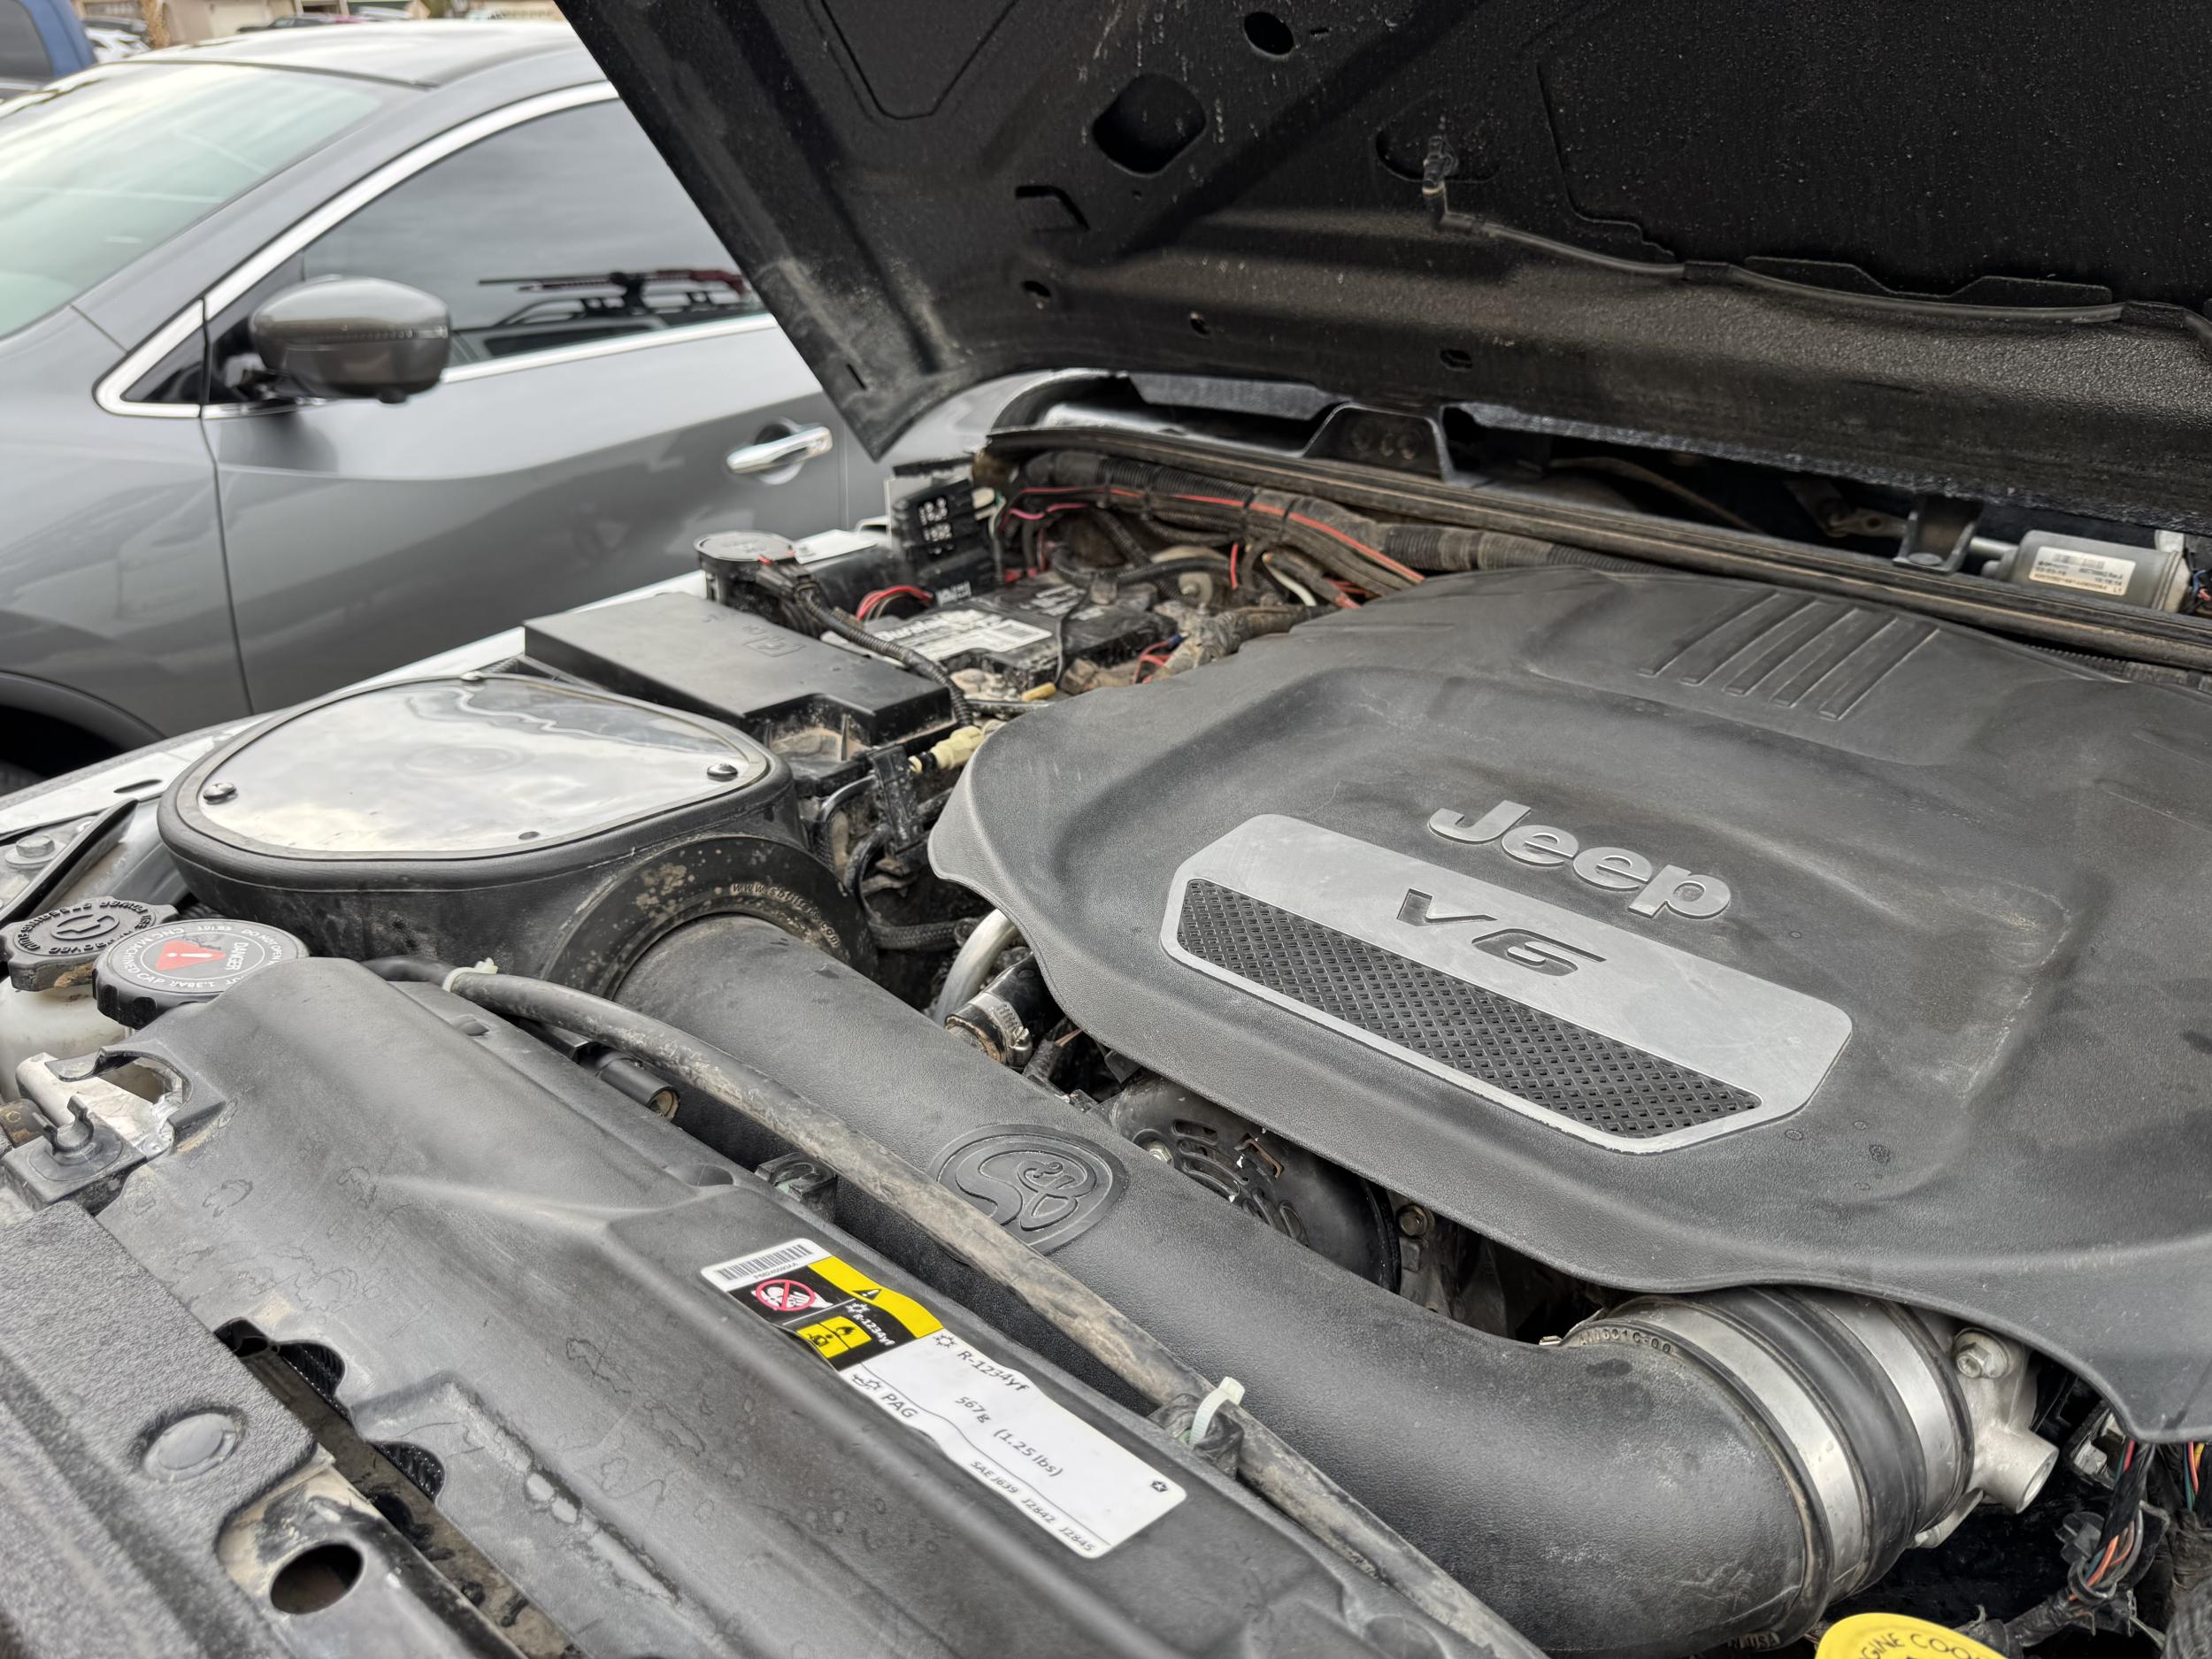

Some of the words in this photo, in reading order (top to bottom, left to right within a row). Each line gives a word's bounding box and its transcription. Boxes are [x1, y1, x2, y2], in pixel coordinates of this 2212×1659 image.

[1426, 799, 1732, 920] Jeep
[1396, 887, 1608, 976] V6
[225, 941, 249, 971] DANGER
[136, 972, 165, 983] CAP
[853, 1313, 895, 1346] R-1234yf
[956, 1349, 1030, 1393] R-1234yf
[881, 1393, 918, 1418] PAG
[955, 1395, 992, 1424] 567g
[971, 1461, 995, 1478] SAE
[991, 1477, 1019, 1494] J639
